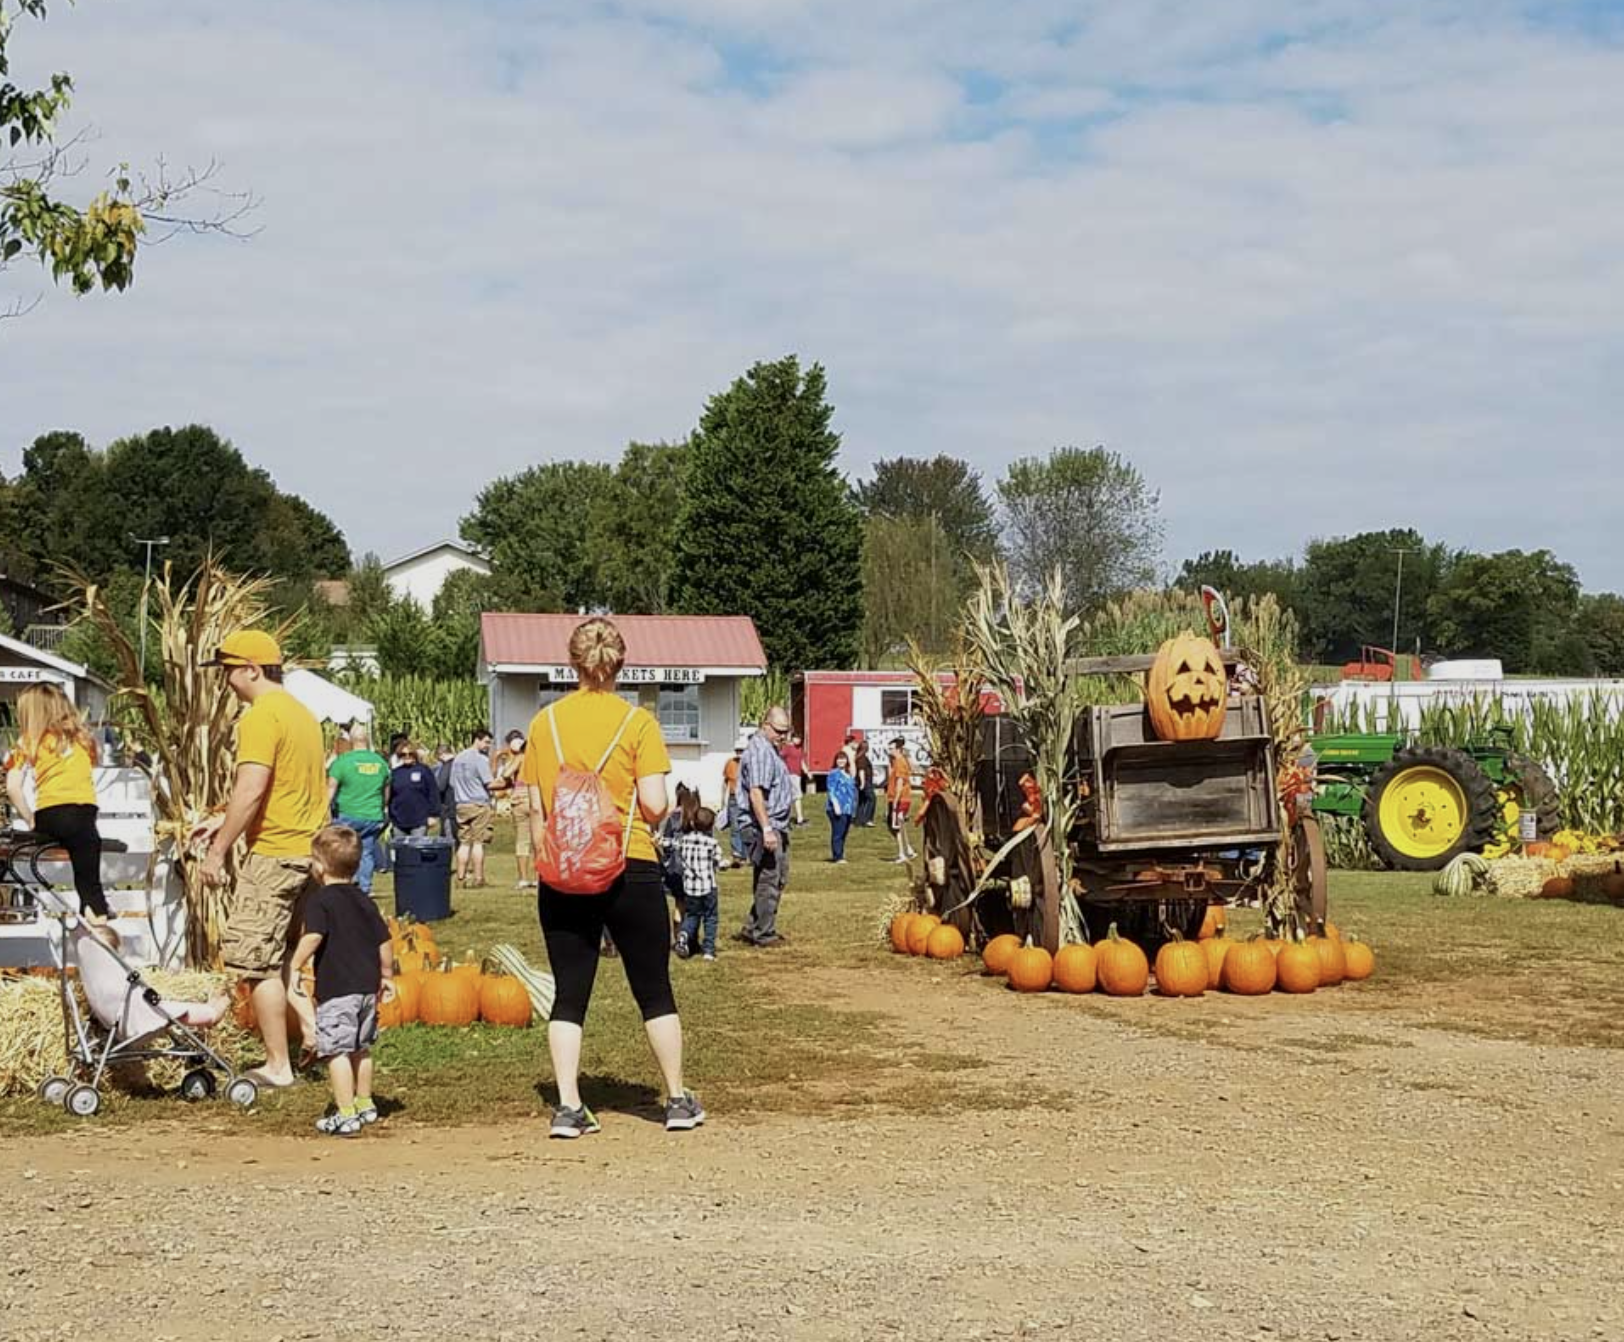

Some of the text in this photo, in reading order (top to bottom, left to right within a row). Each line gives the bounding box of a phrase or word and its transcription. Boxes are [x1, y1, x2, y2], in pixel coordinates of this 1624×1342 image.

[554, 668, 700, 681] MA KETS HERE
